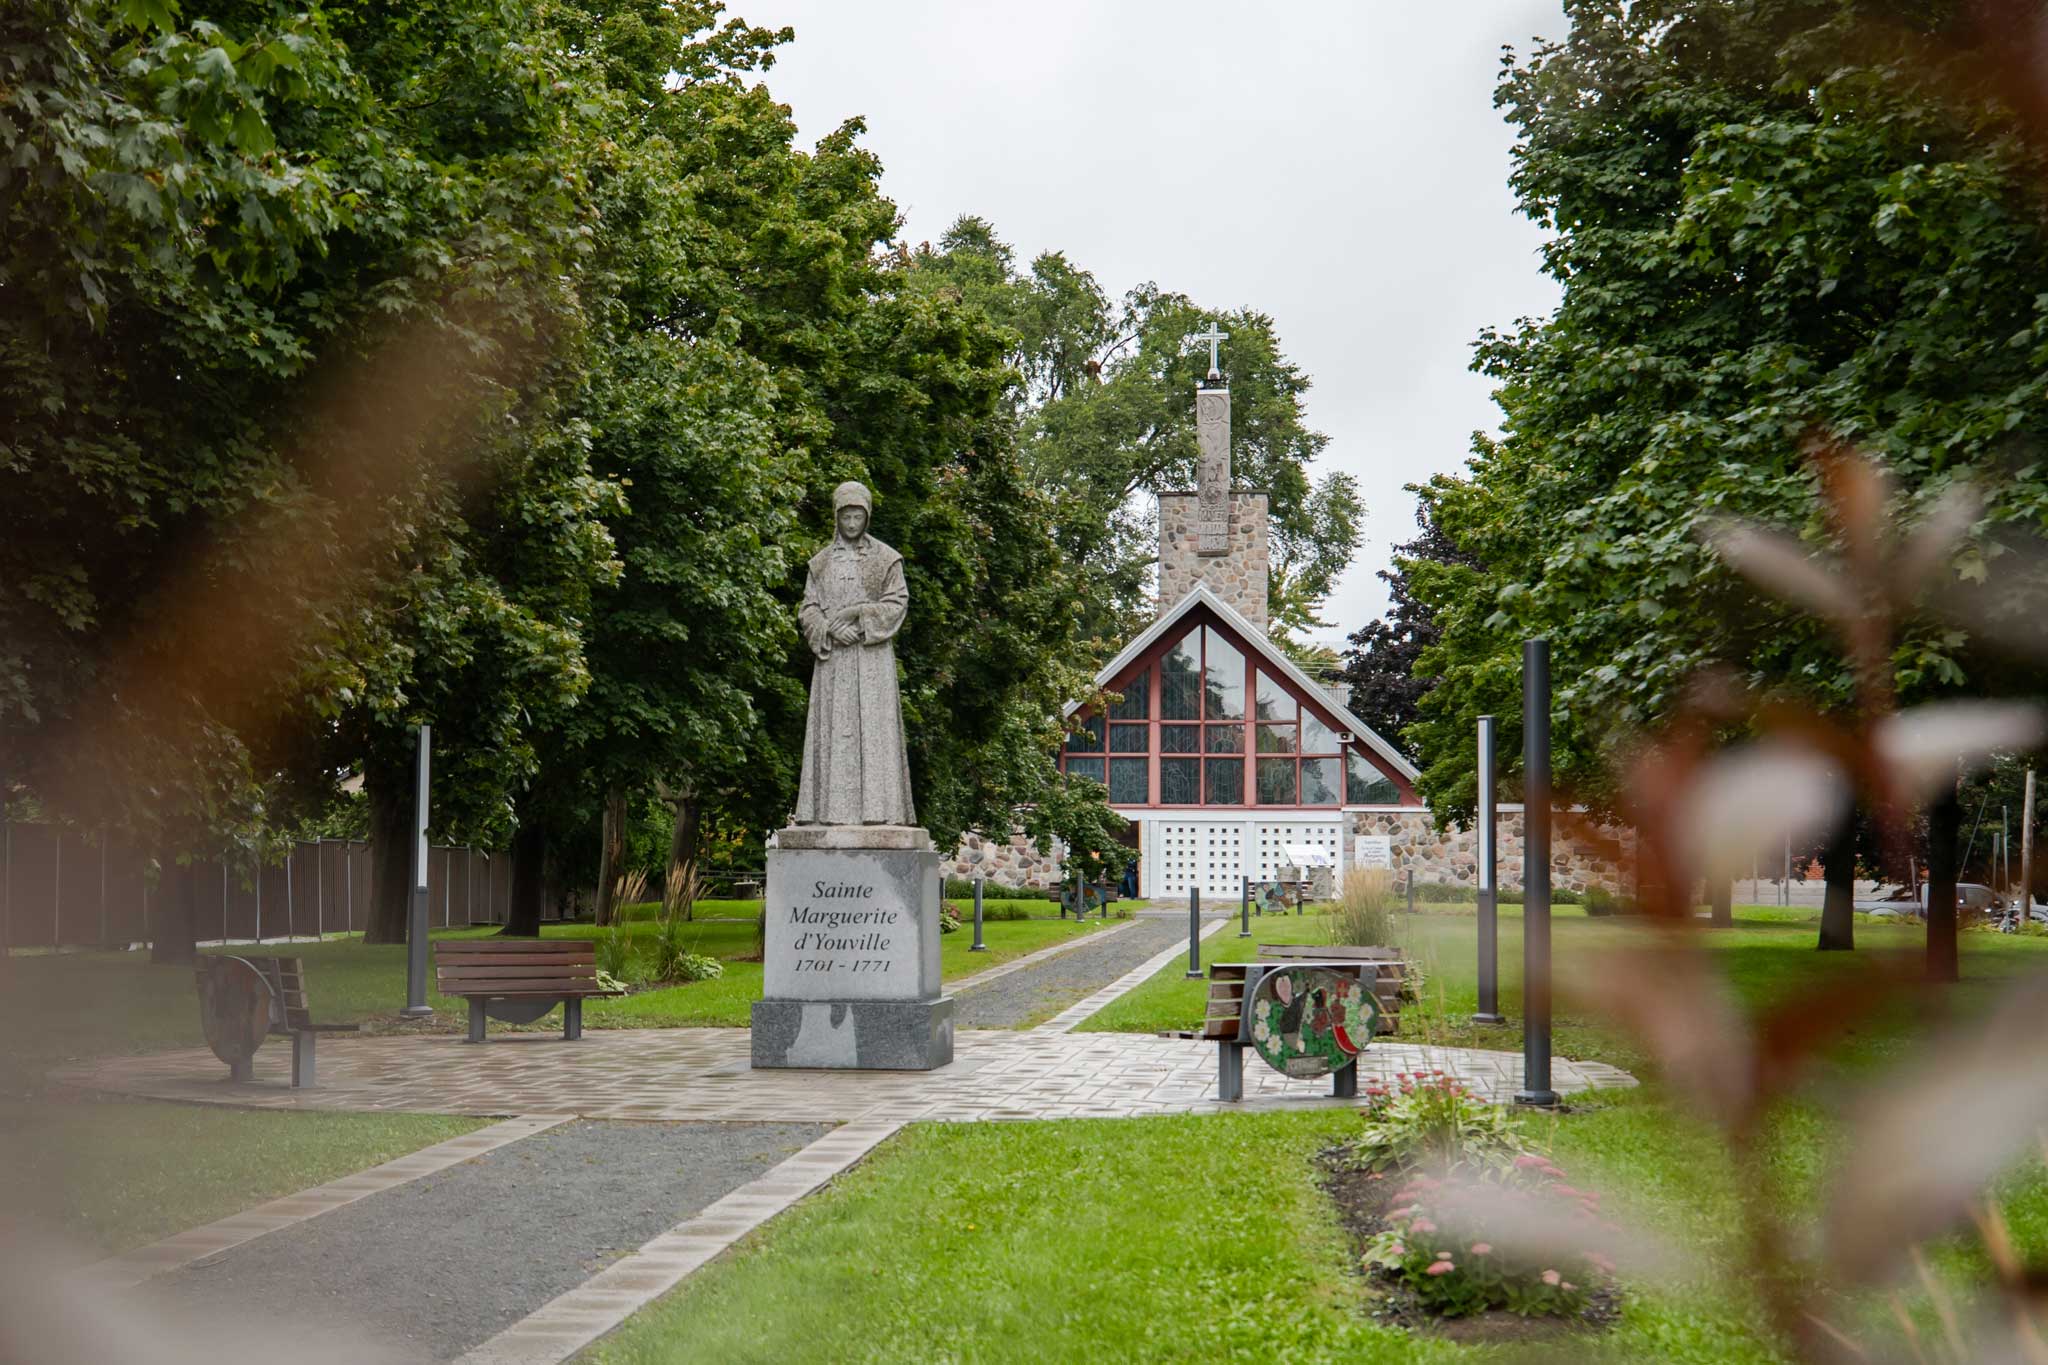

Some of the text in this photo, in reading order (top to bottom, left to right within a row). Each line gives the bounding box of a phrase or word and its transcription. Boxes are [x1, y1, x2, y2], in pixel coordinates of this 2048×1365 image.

[812, 881, 872, 898] Sainte
[790, 907, 897, 928] Marguerite
[794, 932, 890, 950] d'Youville
[796, 960, 833, 971] 1701
[852, 960, 890, 972] 1771
